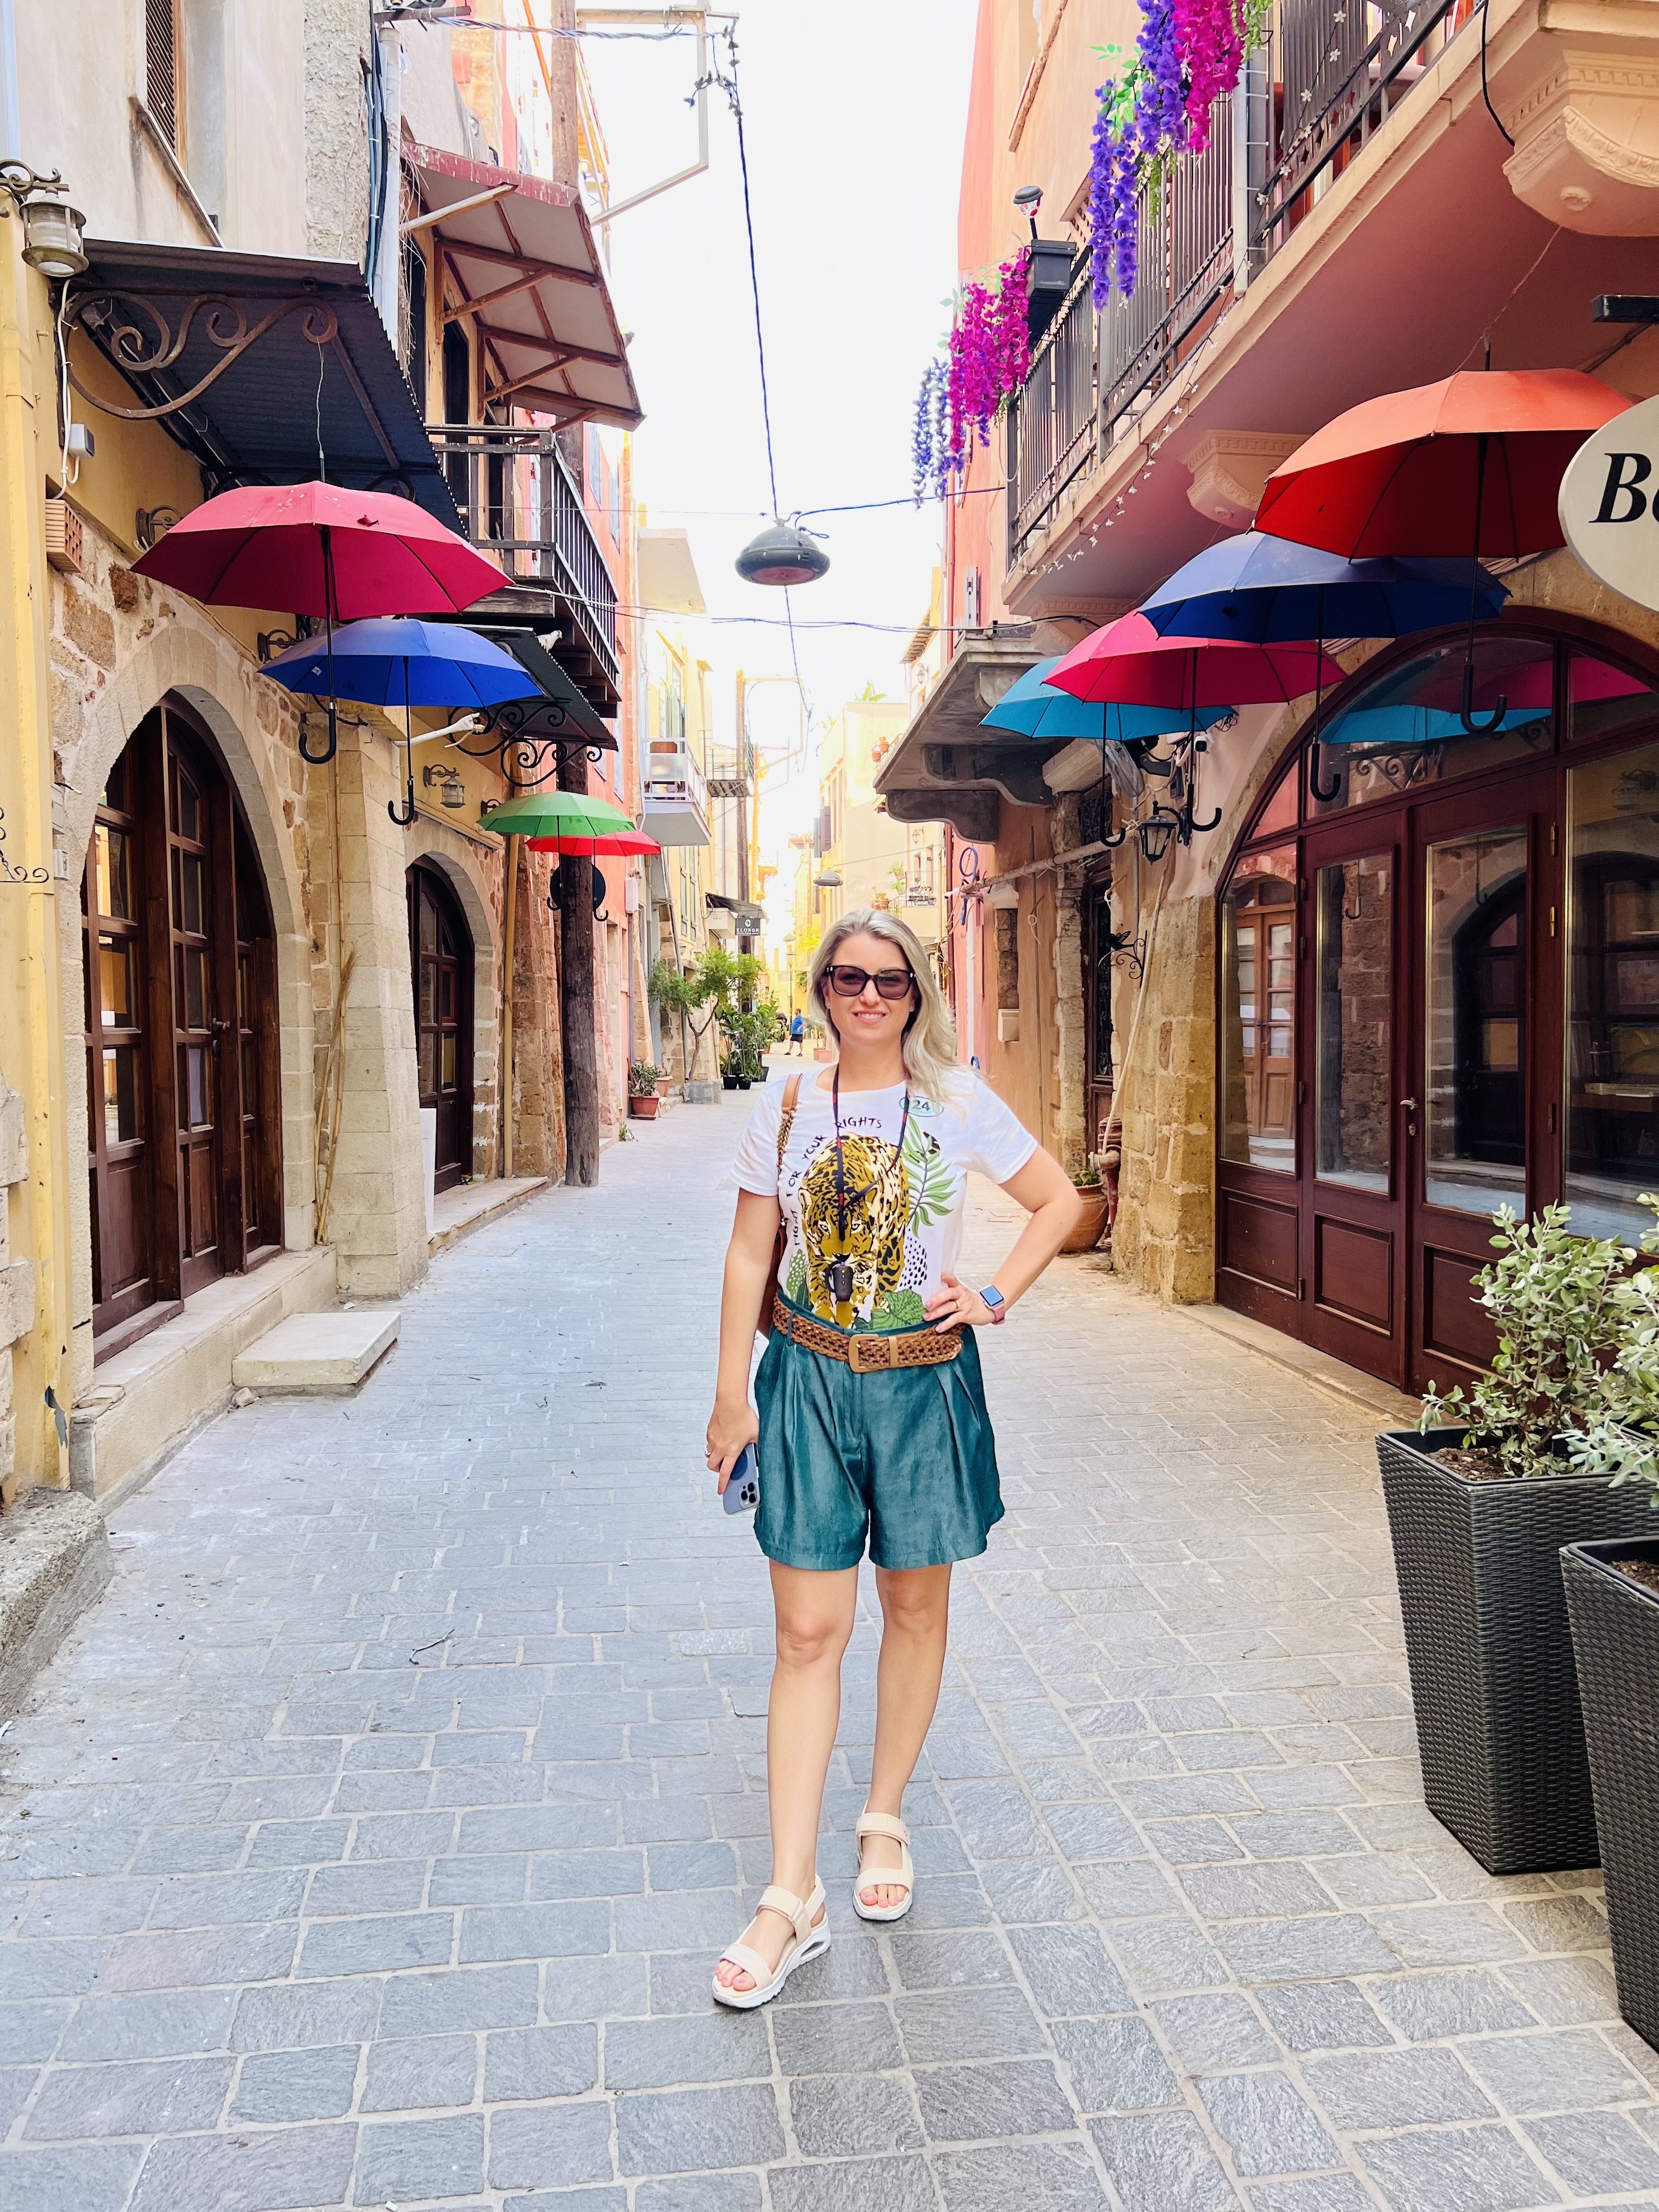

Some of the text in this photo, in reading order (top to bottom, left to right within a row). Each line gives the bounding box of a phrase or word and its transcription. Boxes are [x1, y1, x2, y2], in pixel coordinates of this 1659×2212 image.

[1588, 453, 1659, 523] B
[786, 1170, 802, 1197] FOR
[801, 1135, 829, 1160] YOUR
[834, 1116, 882, 1128] RIGHTS
